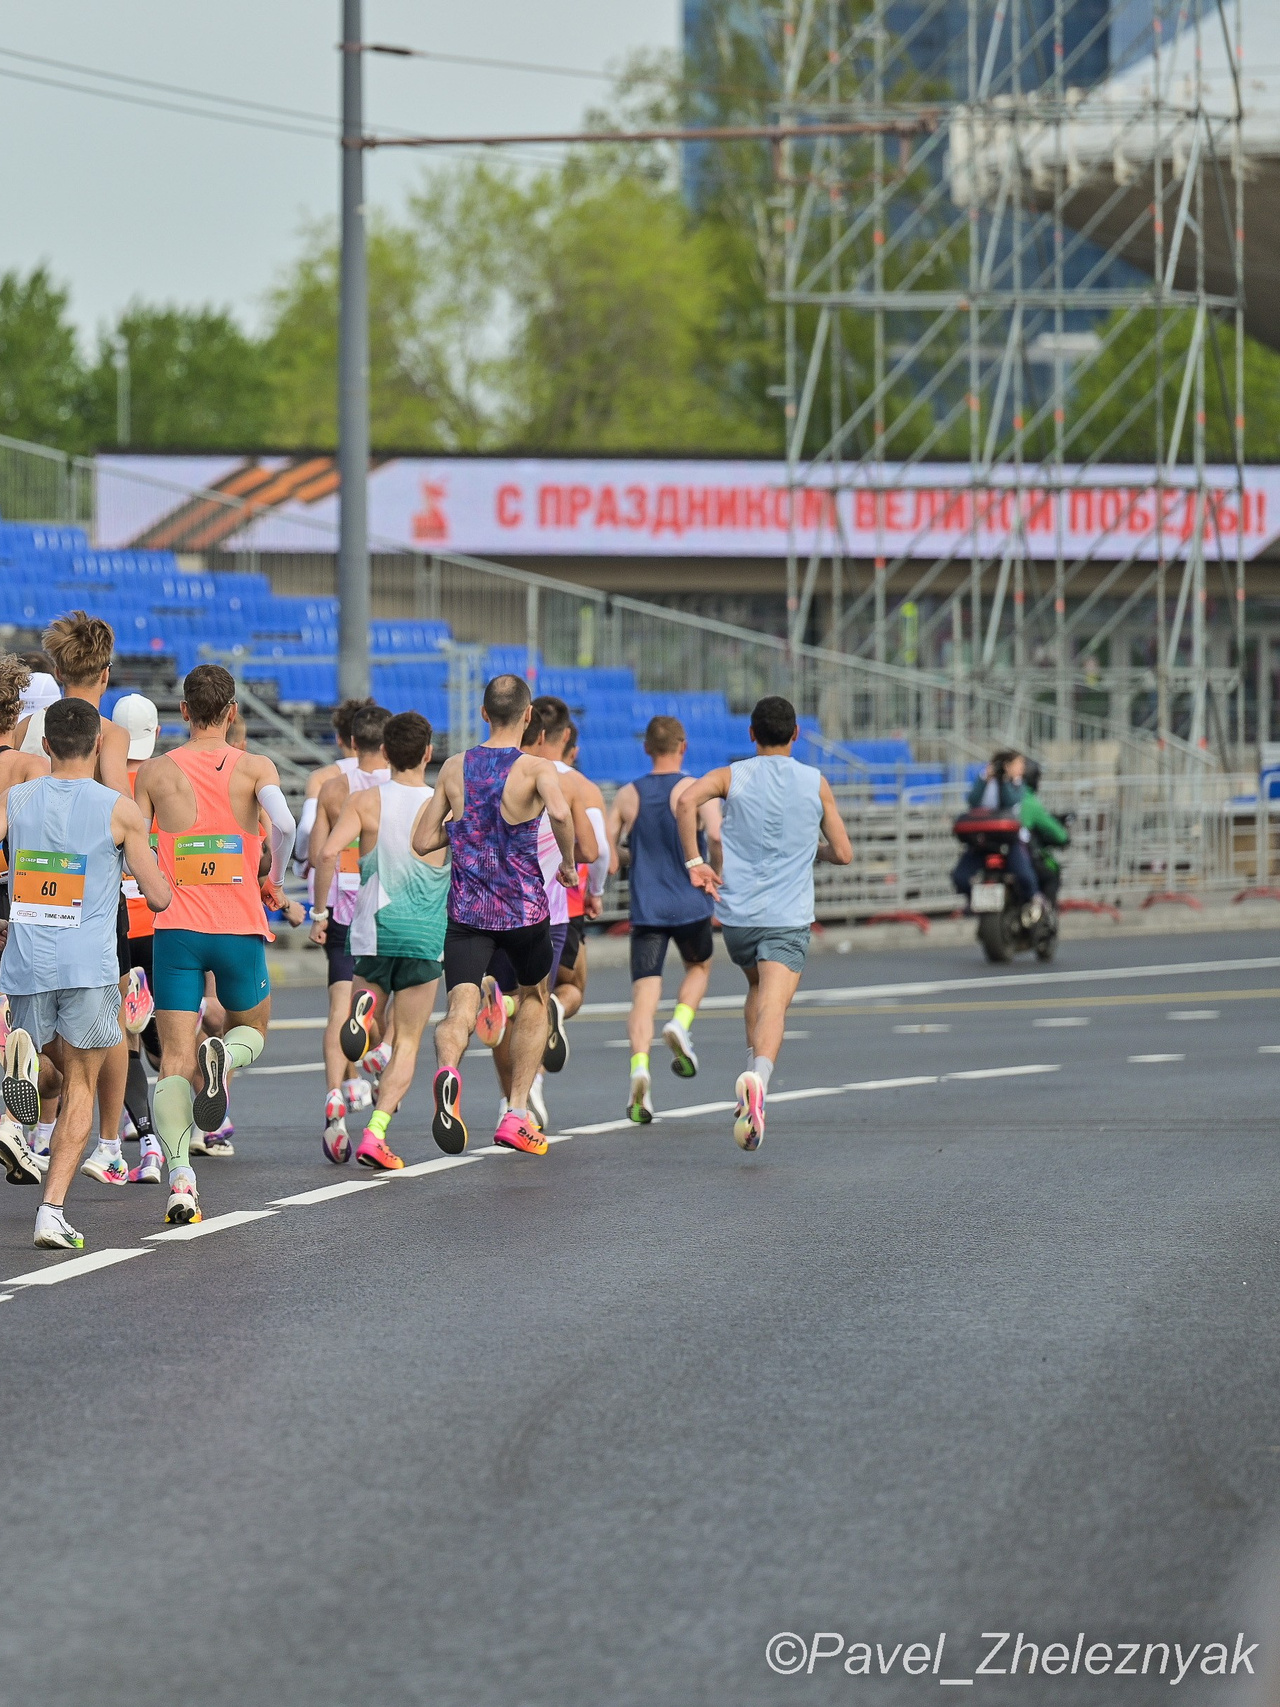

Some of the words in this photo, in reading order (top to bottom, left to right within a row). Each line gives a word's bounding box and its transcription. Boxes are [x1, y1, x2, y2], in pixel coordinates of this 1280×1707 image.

[494, 484, 522, 528] С
[537, 484, 839, 538] ПРАЗДНИКОМ
[200, 862, 216, 876] 49
[41, 881, 57, 897] 60
